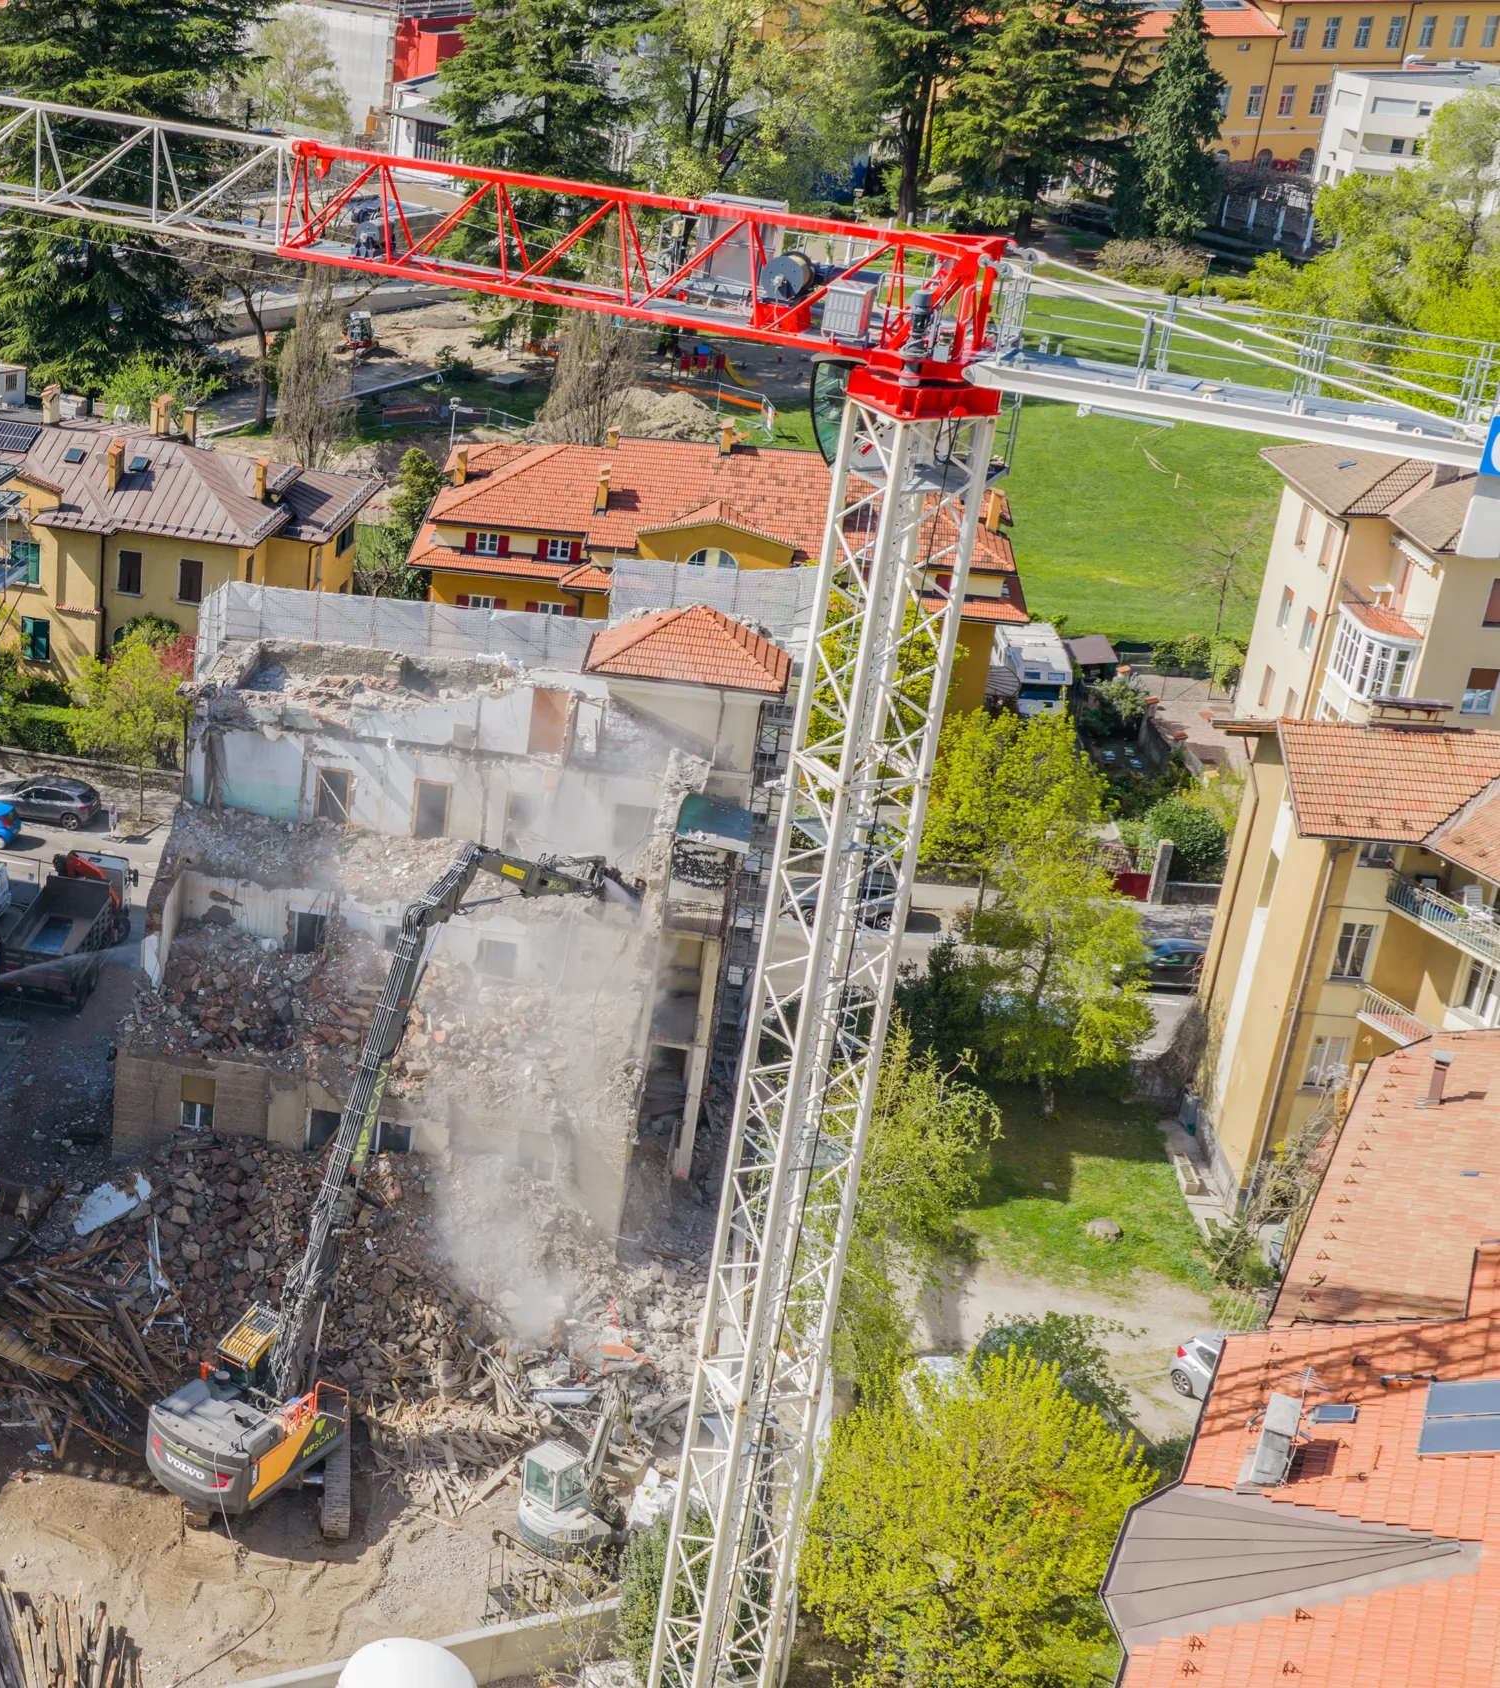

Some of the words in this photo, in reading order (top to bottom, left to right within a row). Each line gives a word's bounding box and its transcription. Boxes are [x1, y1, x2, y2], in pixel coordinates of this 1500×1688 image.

[546, 879, 569, 892] PSCAVI
[354, 1063, 391, 1162] MPSCAVI
[303, 1426, 337, 1458] MPSCAVI
[165, 1452, 205, 1480] VOLVO
